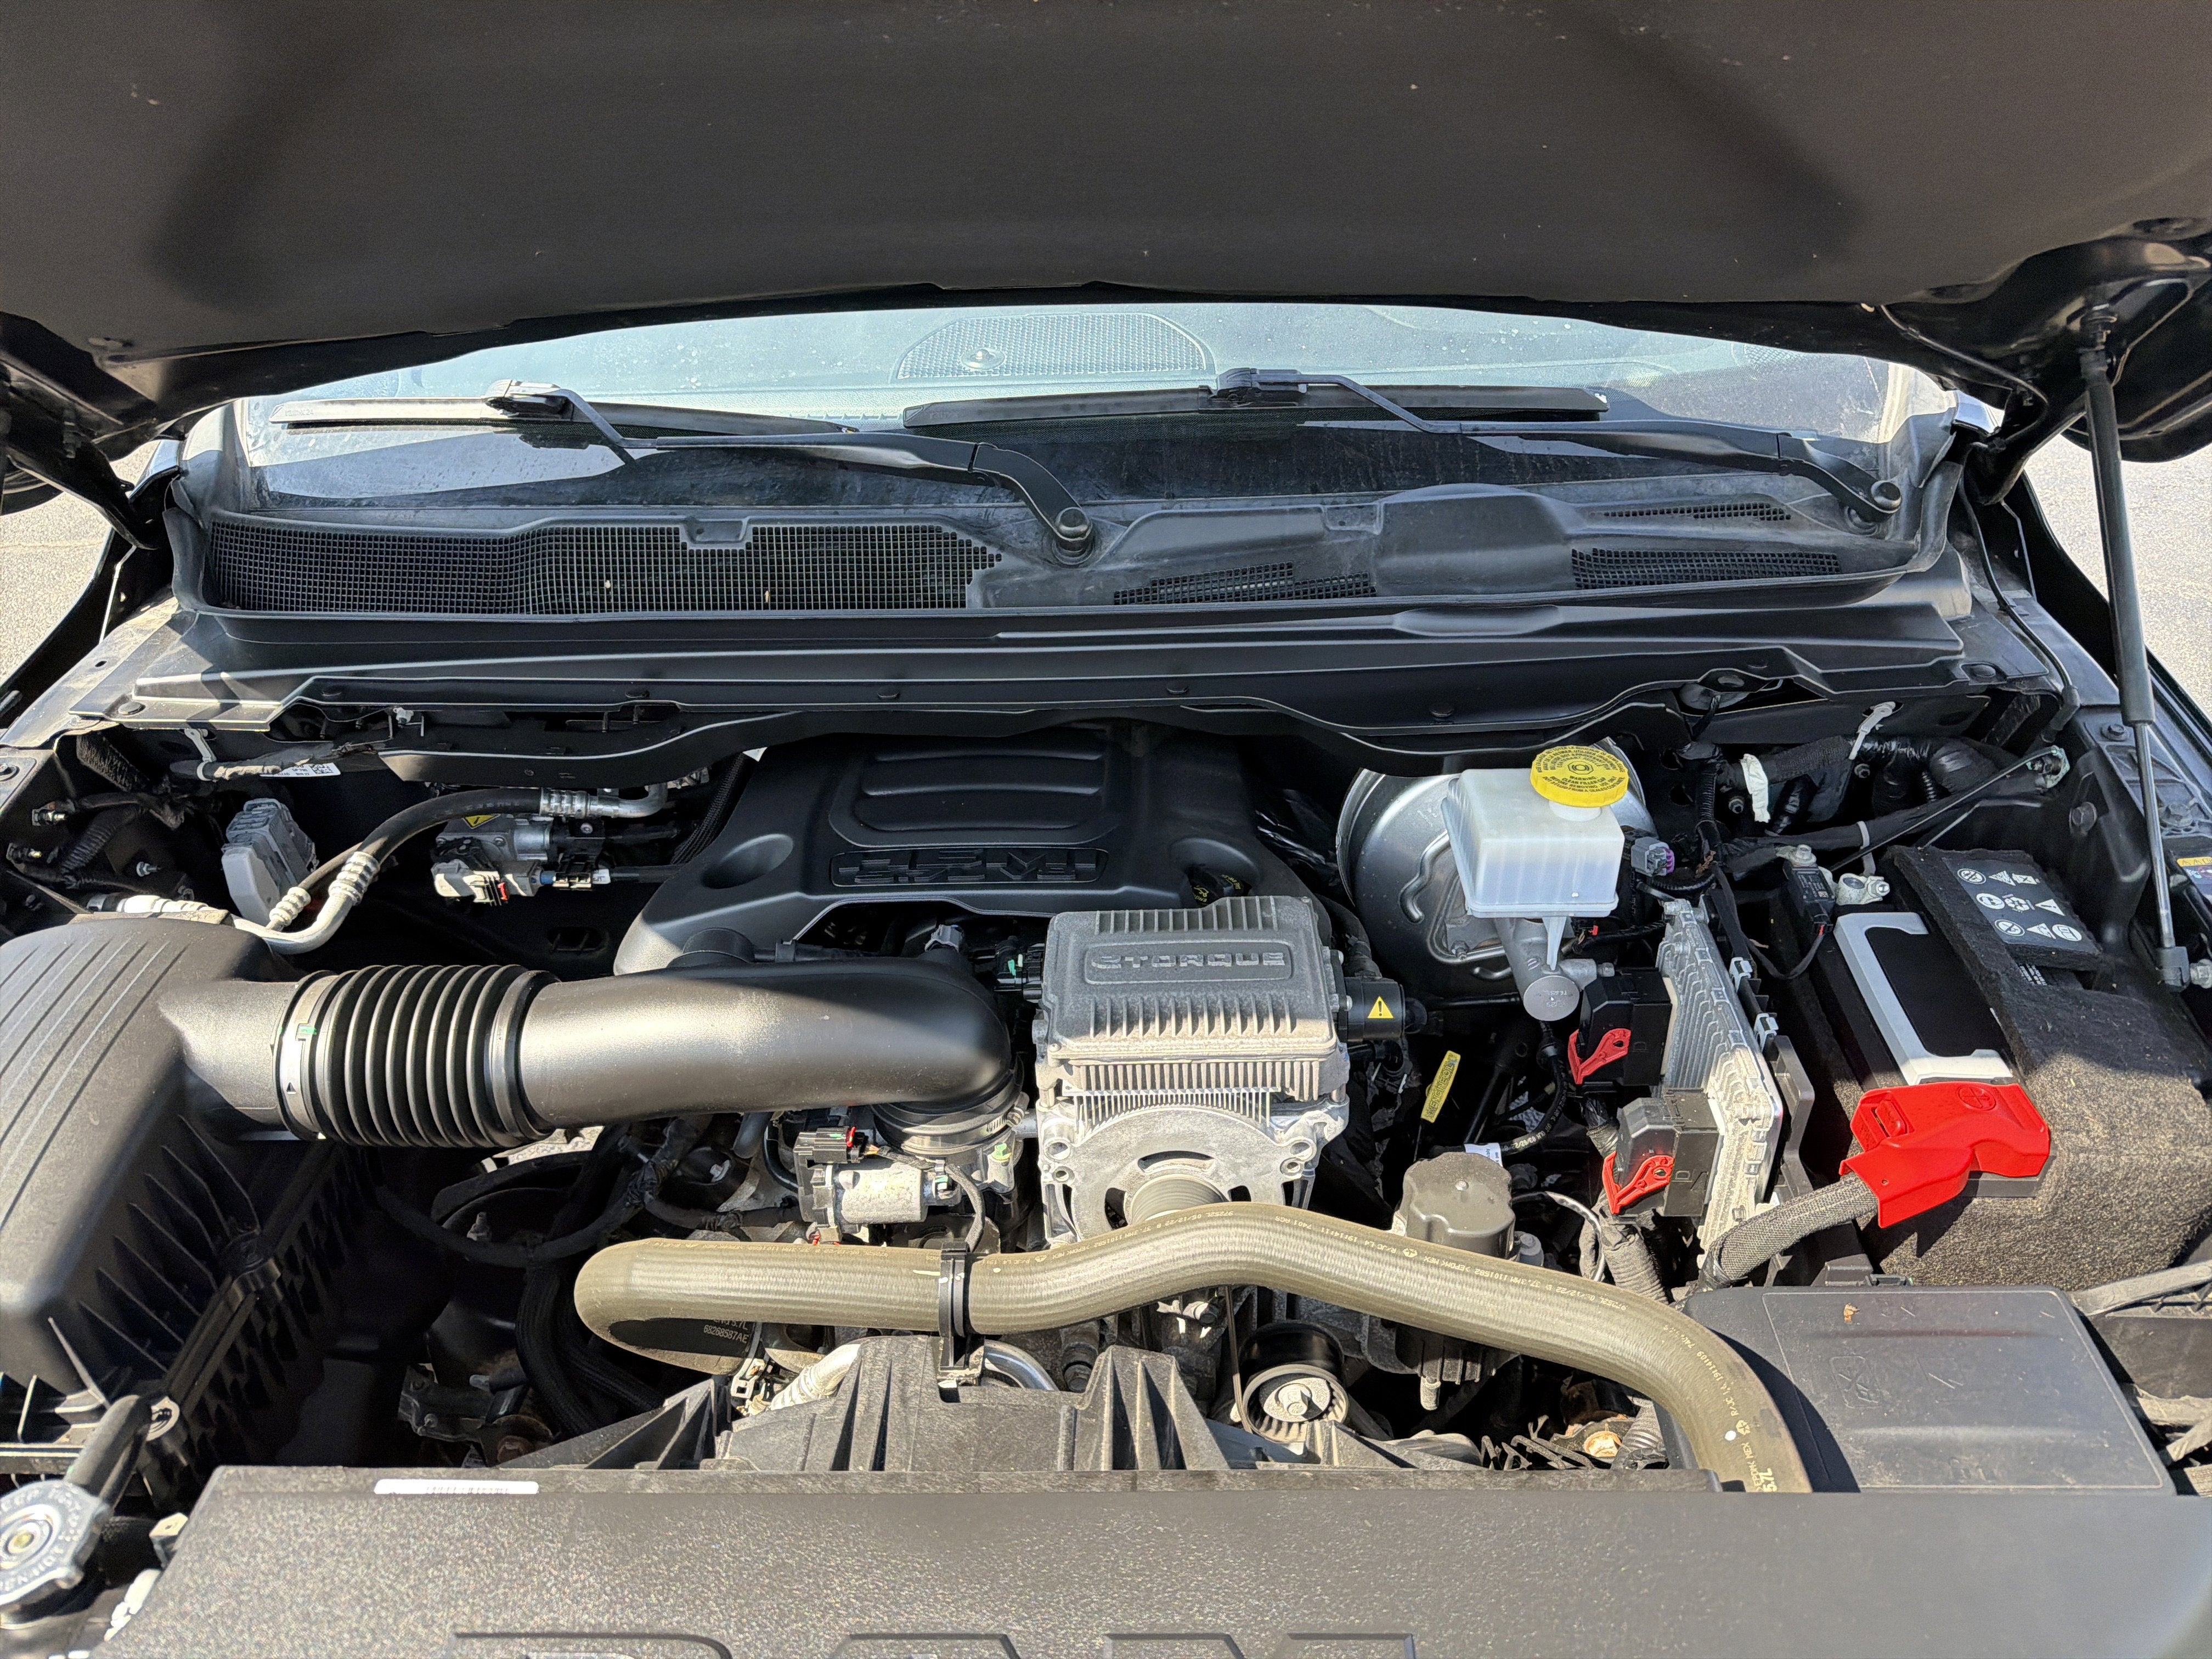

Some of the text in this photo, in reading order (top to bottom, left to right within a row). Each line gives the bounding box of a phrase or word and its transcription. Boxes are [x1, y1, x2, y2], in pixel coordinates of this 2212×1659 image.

[1430, 1077, 1448, 1108] ENGINE
[1165, 1214, 1202, 1226] 05/12/22
[1294, 1220, 1312, 1230] 7401
[1093, 1234, 1122, 1248] 1101582
[1364, 1240, 1375, 1248] L4
[1377, 1244, 1396, 1254] R/JC
[1052, 1251, 1065, 1260] MEX
[1424, 1256, 1439, 1265] MEX
[1475, 1268, 1507, 1281] 1101582
[703, 1324, 749, 1344] 68268587AE
[1741, 1442, 1754, 1459] MEX
[1758, 1468, 1778, 1492] 5.7L
